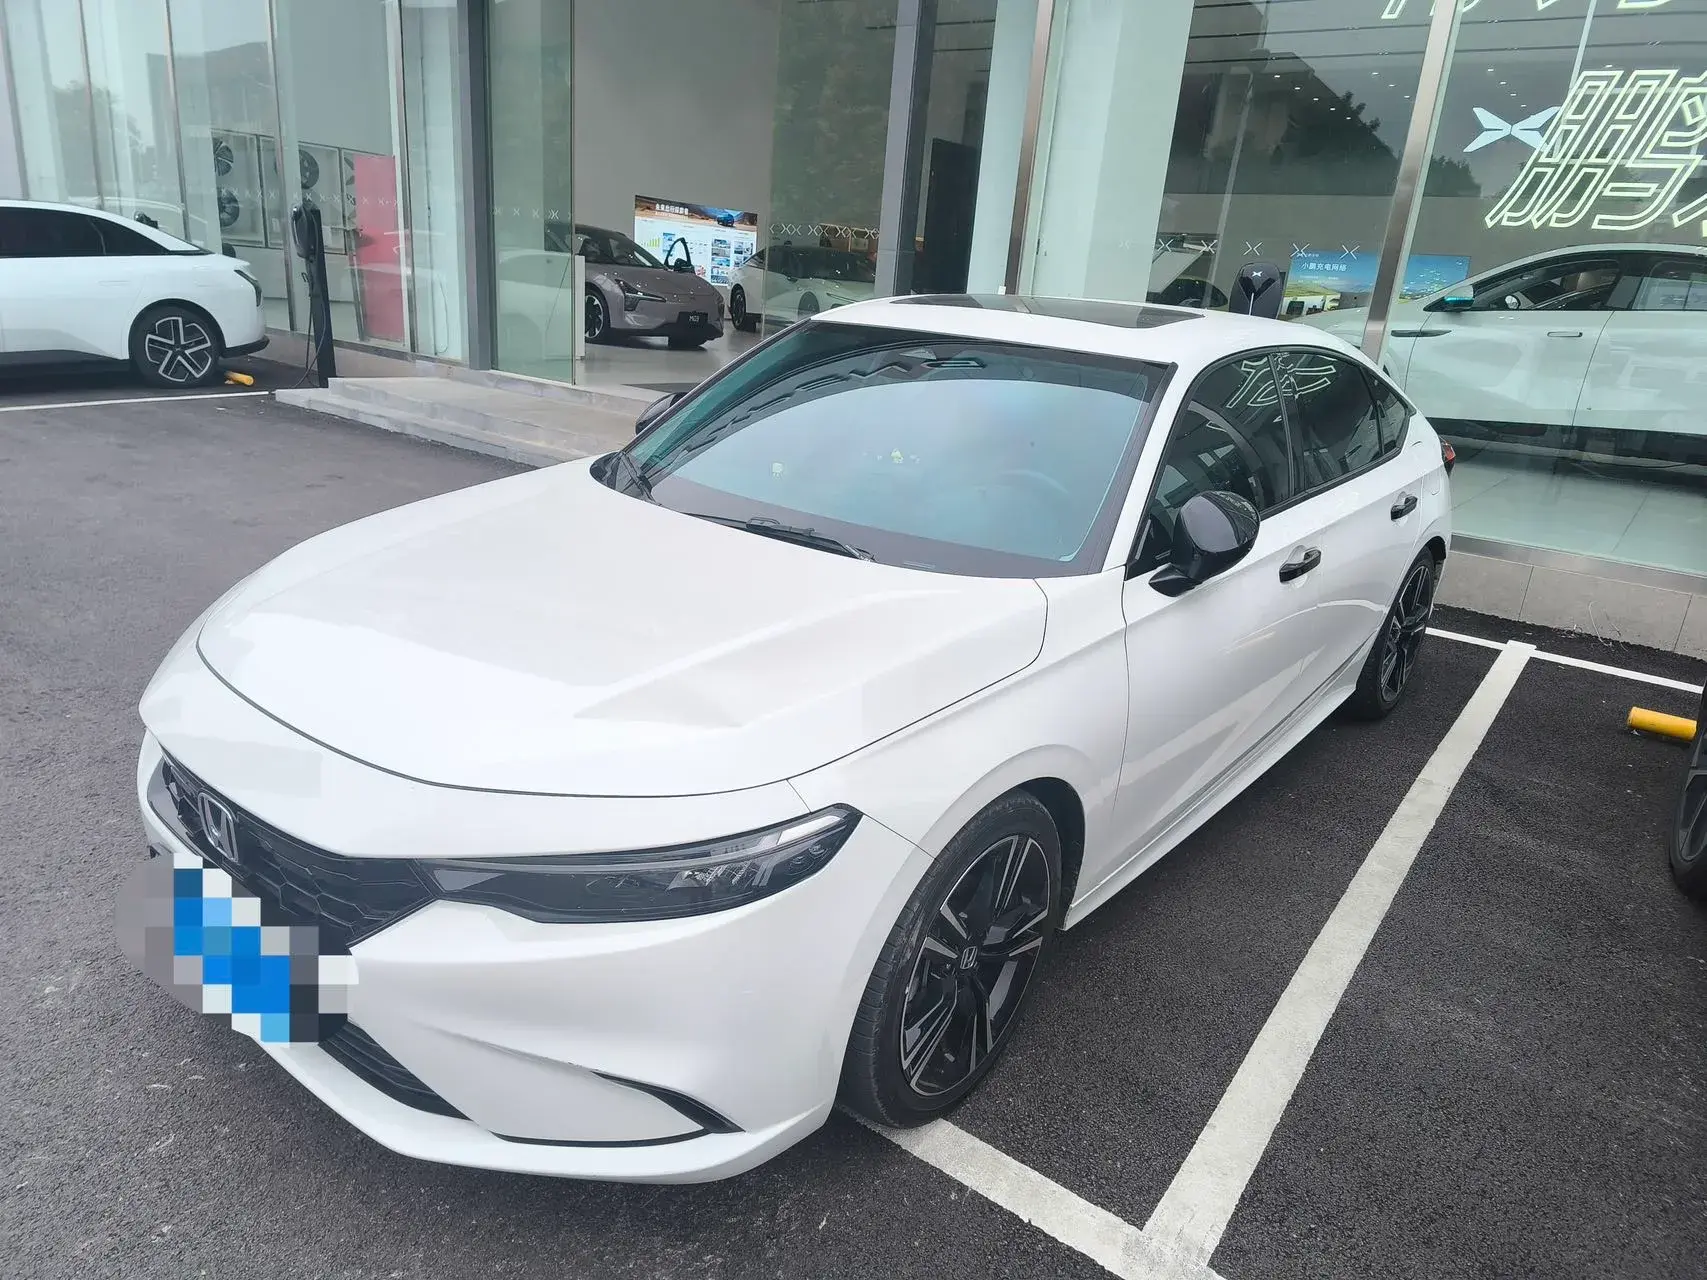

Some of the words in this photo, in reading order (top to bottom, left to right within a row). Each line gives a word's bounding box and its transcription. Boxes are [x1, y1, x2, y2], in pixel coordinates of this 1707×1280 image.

[1484, 68, 1707, 237] 鹏
[1301, 262, 1347, 272] 小鹏充电网络
